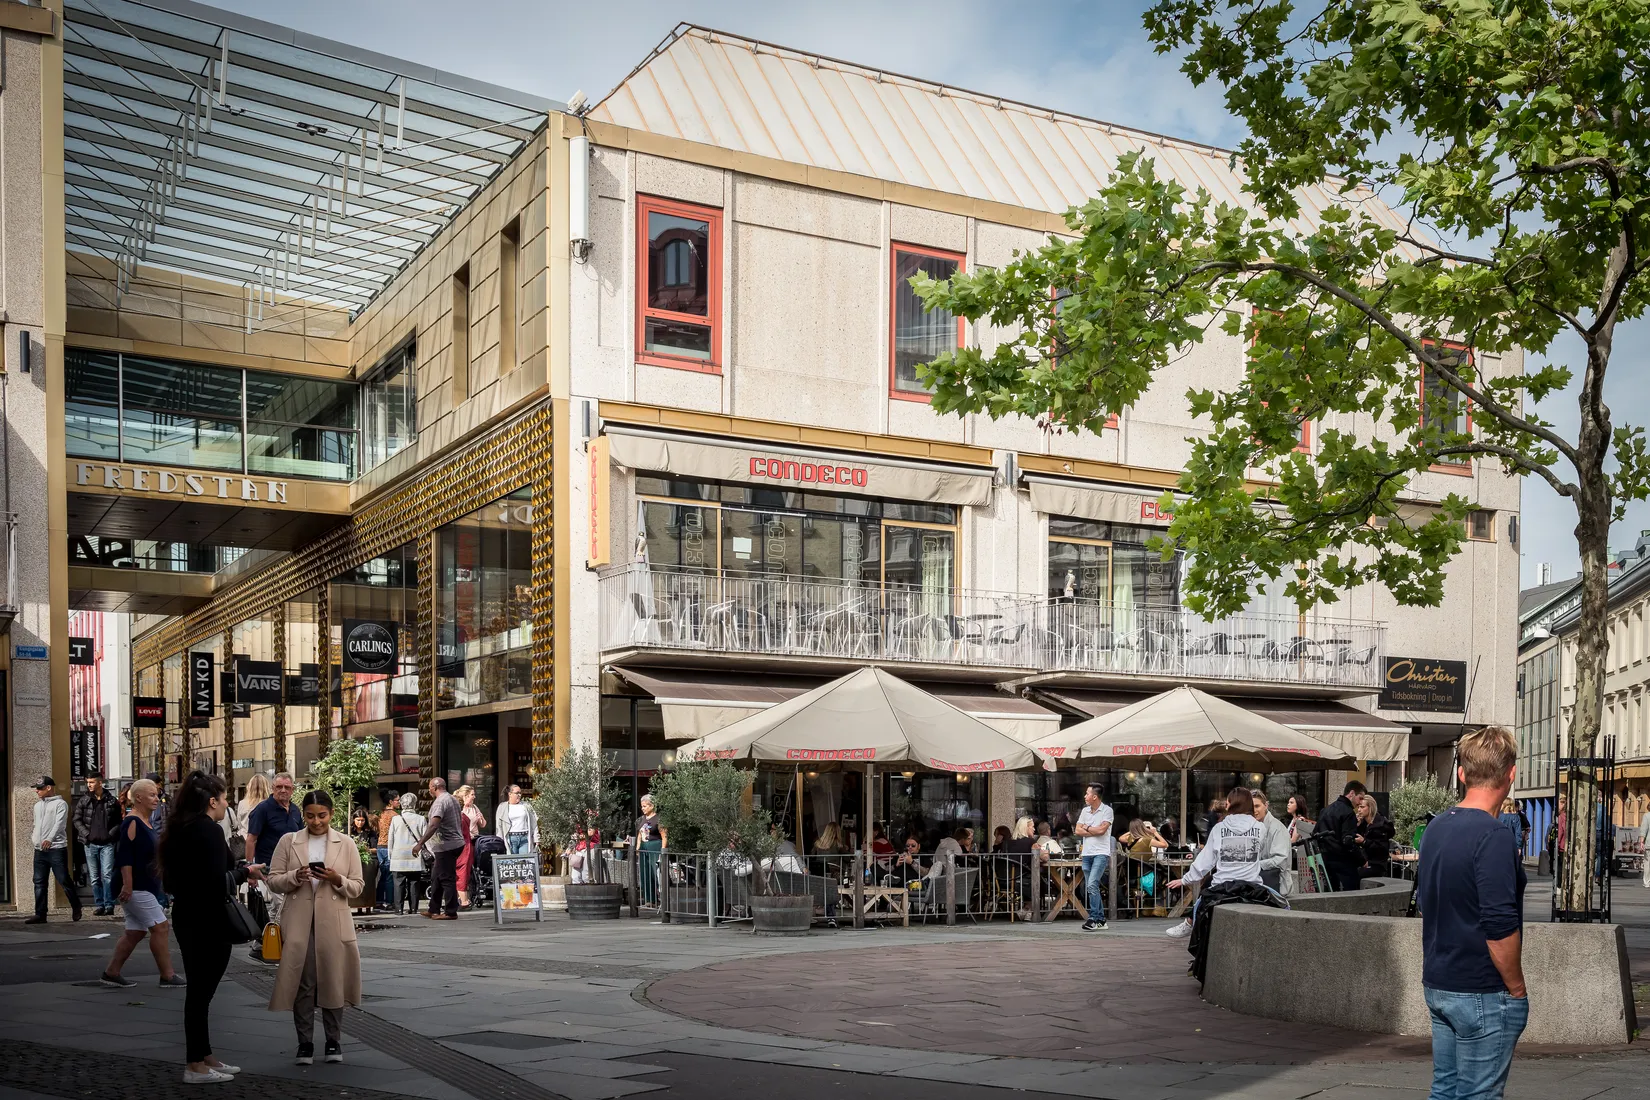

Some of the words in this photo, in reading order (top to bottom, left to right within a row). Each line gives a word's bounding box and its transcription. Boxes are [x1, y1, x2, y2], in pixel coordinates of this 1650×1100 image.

[750, 457, 868, 487] CONDECO
[77, 463, 288, 503] FREDSTAN
[1141, 502, 1174, 521] CO
[349, 640, 393, 655] CARLINGS
[1386, 660, 1458, 684] Christers
[238, 673, 280, 691] VANS
[1392, 691, 1427, 702] Tidsbokning
[1432, 693, 1445, 703] Drop
[787, 748, 876, 760] CONDECO
[500, 870, 515, 878] ICE
[515, 869, 534, 877] TEA
